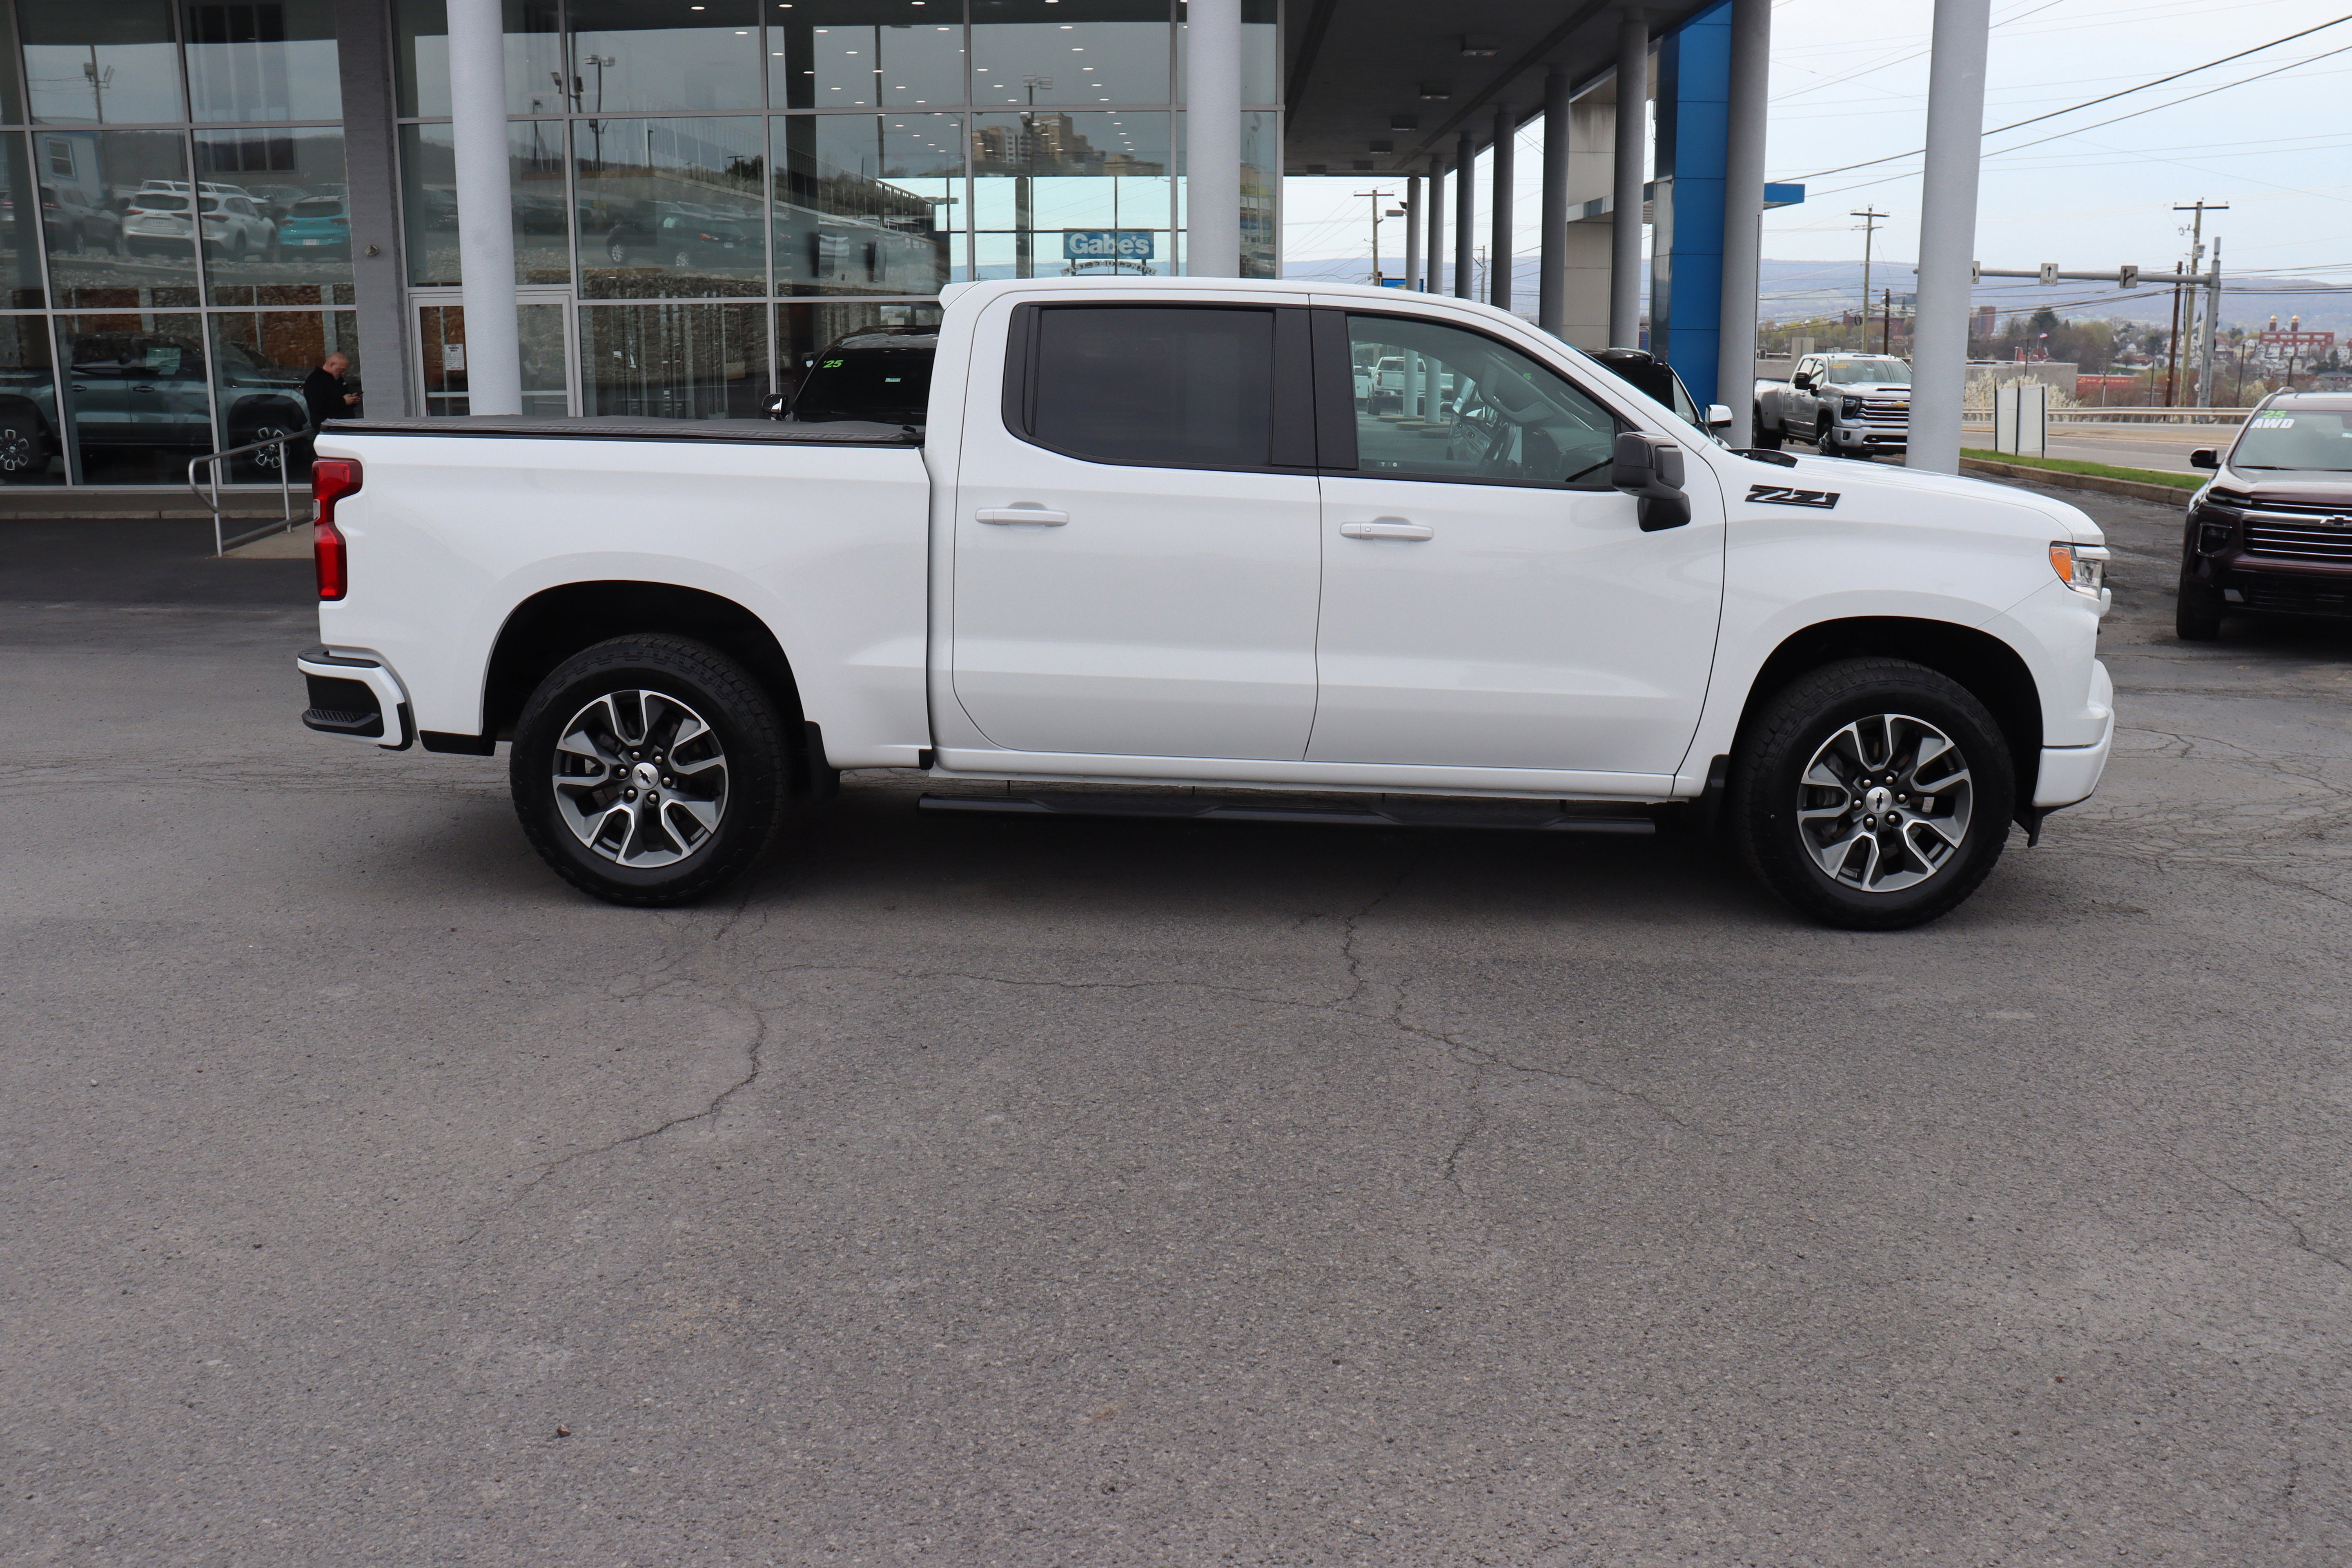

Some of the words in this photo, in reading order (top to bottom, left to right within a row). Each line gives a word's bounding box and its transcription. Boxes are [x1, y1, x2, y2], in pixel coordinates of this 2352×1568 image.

[1069, 233, 1150, 254] Gabe's
[1060, 262, 1092, 276] EAST
[1117, 261, 1158, 276] CENTRE
[823, 360, 844, 368] '25
[2250, 419, 2295, 428] AWD
[1745, 484, 1841, 509] Z71
